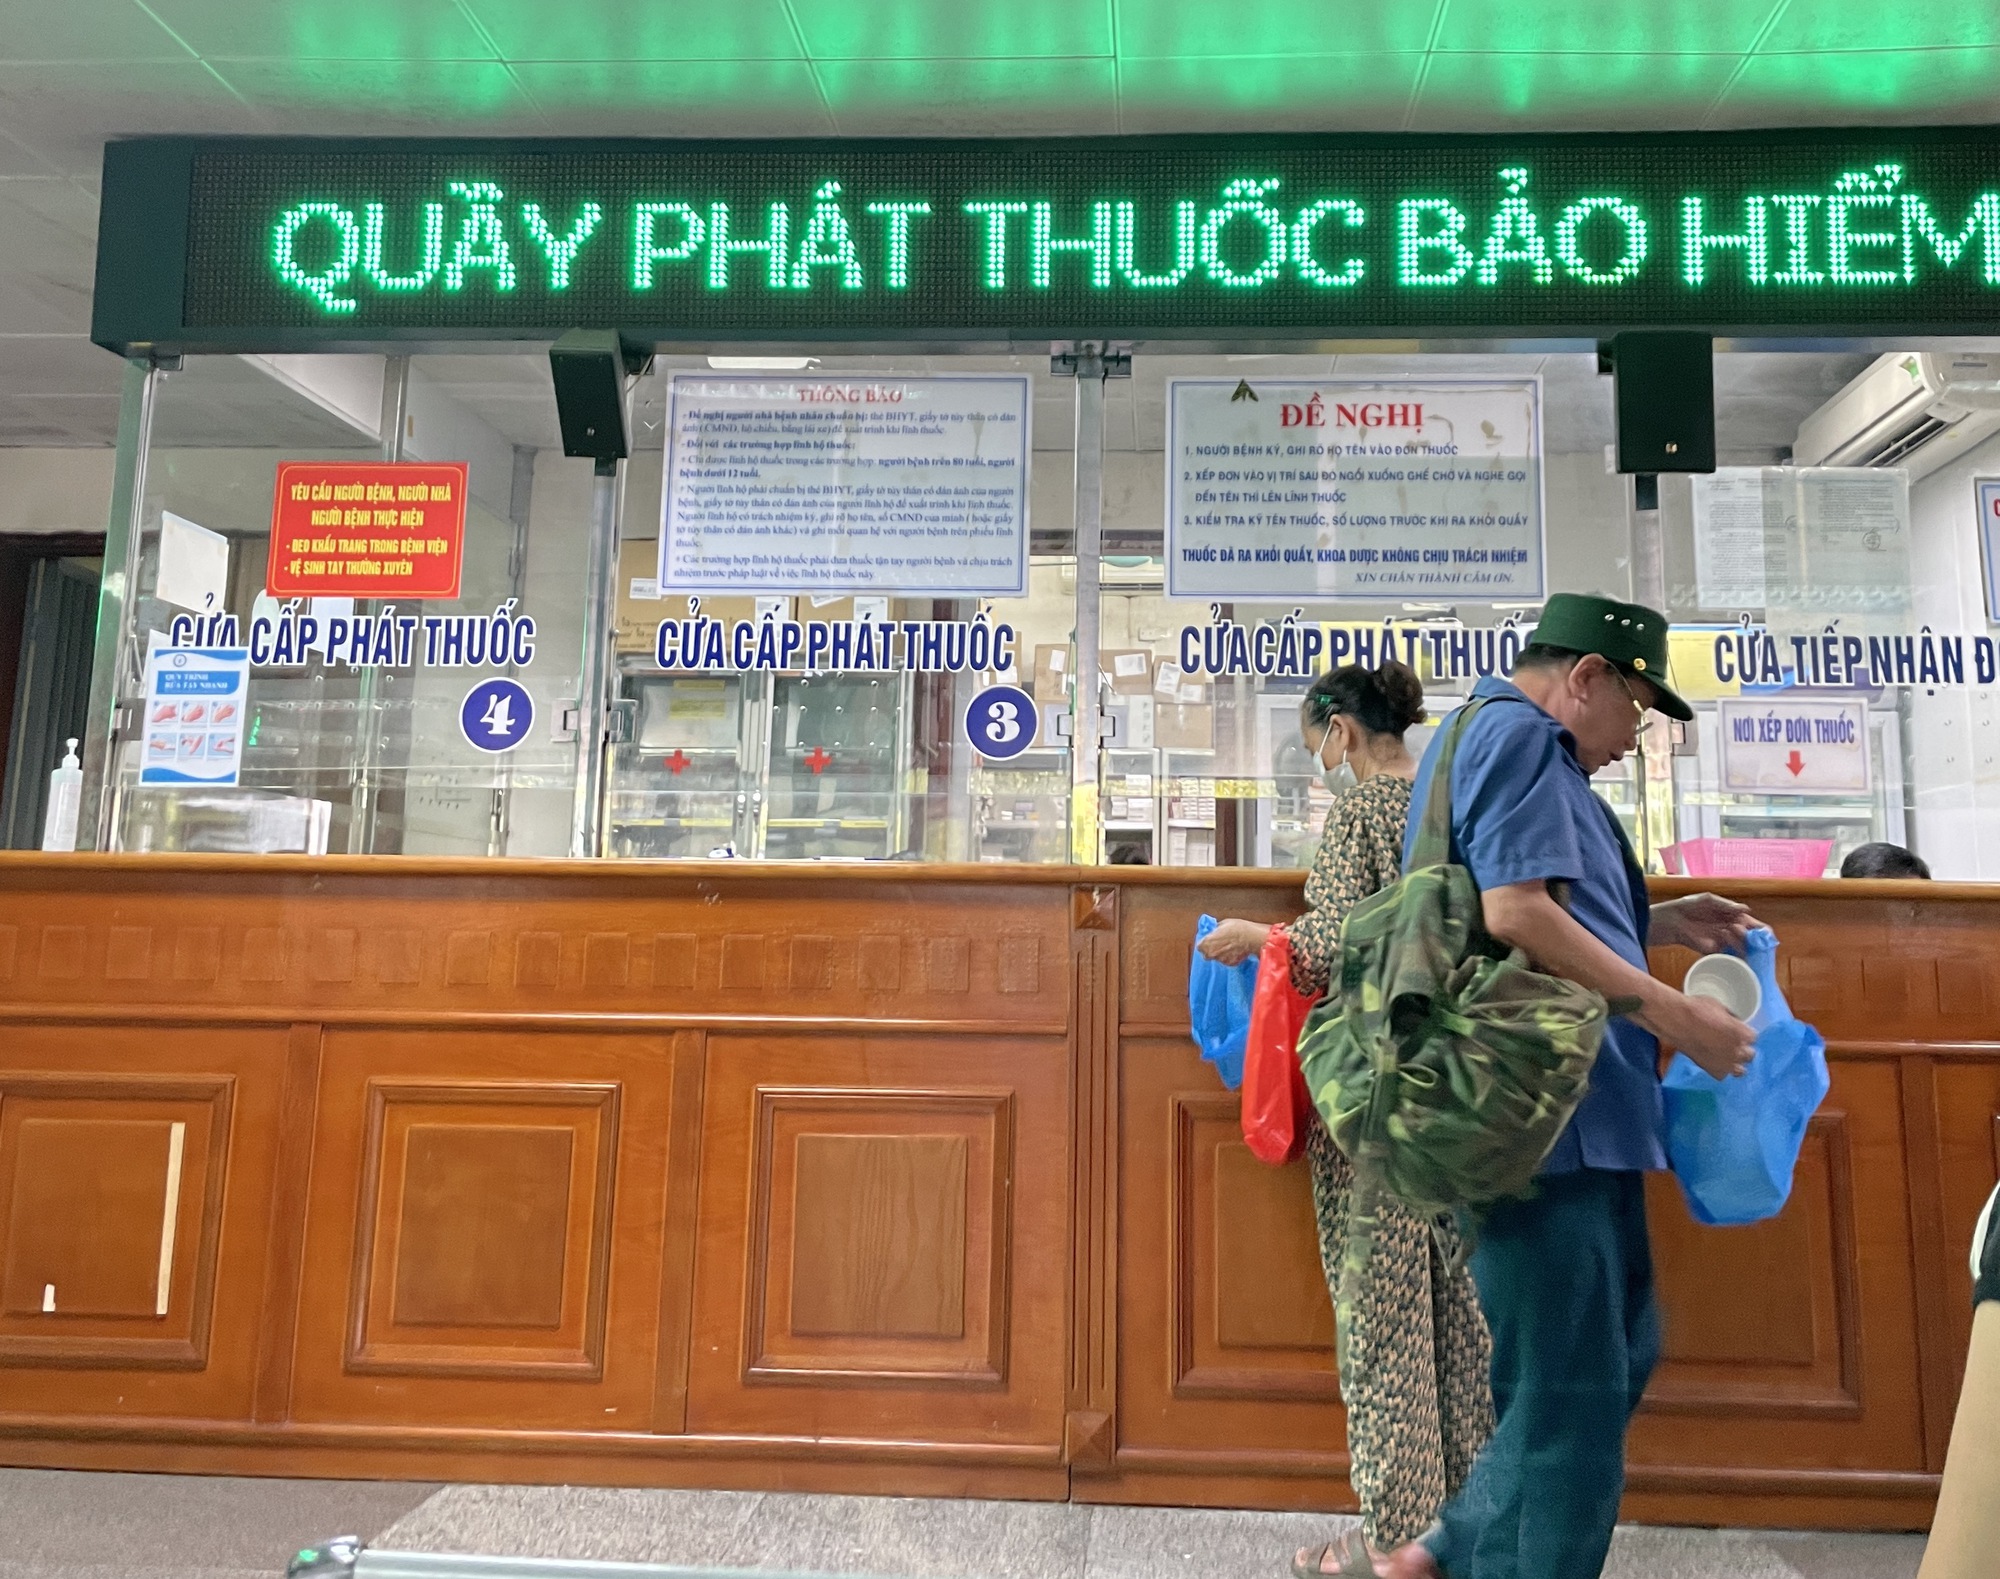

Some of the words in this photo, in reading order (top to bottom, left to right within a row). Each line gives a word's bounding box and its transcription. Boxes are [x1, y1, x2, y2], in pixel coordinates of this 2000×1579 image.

[632, 179, 931, 290] PHÁT
[964, 178, 1365, 288] THUỐC
[1398, 166, 1648, 285] BẢO
[1680, 163, 2000, 286] HIỂM
[1280, 392, 1325, 427] ĐỀ
[1336, 403, 1424, 433] NGHỊ
[1185, 446, 1193, 456] 1.
[1233, 444, 1262, 456] BỆNH
[1287, 446, 1305, 455] GHI
[1346, 445, 1366, 455] TÊN
[1370, 444, 1392, 455] VÀO
[1395, 446, 1418, 455] ĐƠN
[1422, 443, 1458, 455] THUỐC
[1184, 471, 1193, 481] 2.
[1196, 467, 1215, 480] XẾP
[1218, 471, 1240, 480] ĐƠN
[1244, 469, 1264, 480] VÀO
[1280, 470, 1296, 480] TRÍ
[1300, 471, 1319, 480] SAU
[1368, 468, 1404, 480] XUỐNG
[1407, 468, 1429, 480] GHẾ
[1458, 469, 1471, 480] VÀ
[1474, 471, 1504, 480] NGHE
[1507, 471, 1526, 482] GỌI
[1196, 489, 1216, 502] ĐẾN
[1220, 491, 1239, 502] TÊN
[1262, 490, 1281, 502] LÊN
[1311, 489, 1346, 502] THUỐC
[344, 507, 371, 529] BỆNH
[400, 507, 424, 529] HIỆN
[1184, 516, 1192, 525] 3.
[1225, 516, 1245, 525] TRA
[1266, 516, 1286, 525] TÊN
[1332, 512, 1347, 525] SỐ
[1430, 516, 1448, 525] KHI
[1452, 516, 1466, 525] RA
[338, 539, 367, 553] TRANG
[370, 539, 398, 553] TRONG
[400, 537, 425, 556] BỆNH
[427, 537, 448, 557] VIỆN
[1183, 544, 1217, 561] THUỐC
[1238, 549, 1252, 561] RA
[1317, 549, 1346, 562] KHOA
[1382, 547, 1419, 562] KHÔNG
[1423, 549, 1449, 565] CHỊU
[1452, 547, 1488, 562] TRÁCH
[1491, 547, 1527, 566] NHIỆM
[303, 561, 325, 574] SINH
[327, 561, 344, 574] TAY
[1355, 573, 1377, 582] XIN
[251, 600, 318, 665] CẤP
[327, 605, 416, 665] PHÁT
[425, 599, 535, 665] THUỐC
[660, 599, 725, 668] CỬA
[735, 605, 800, 669] CẤP
[809, 613, 895, 670] PHÁT
[903, 607, 1014, 670] THUỐC
[1181, 603, 1249, 673] CỬA
[1255, 609, 1322, 675] CẤP
[1331, 618, 1420, 671] PHÁT
[1429, 612, 1536, 677] THUỐ
[1716, 614, 1782, 682] CỬA
[1791, 619, 1862, 683] TIẾP
[1869, 625, 1964, 696] NHẬN
[1974, 636, 2000, 683] Đ
[480, 693, 515, 734] 4
[985, 701, 1020, 742] 3
[1734, 716, 1755, 742] NƠI
[1759, 711, 1782, 742] XẾP
[1786, 716, 1811, 743] ĐƠN
[1815, 710, 1854, 743] THUỐC
